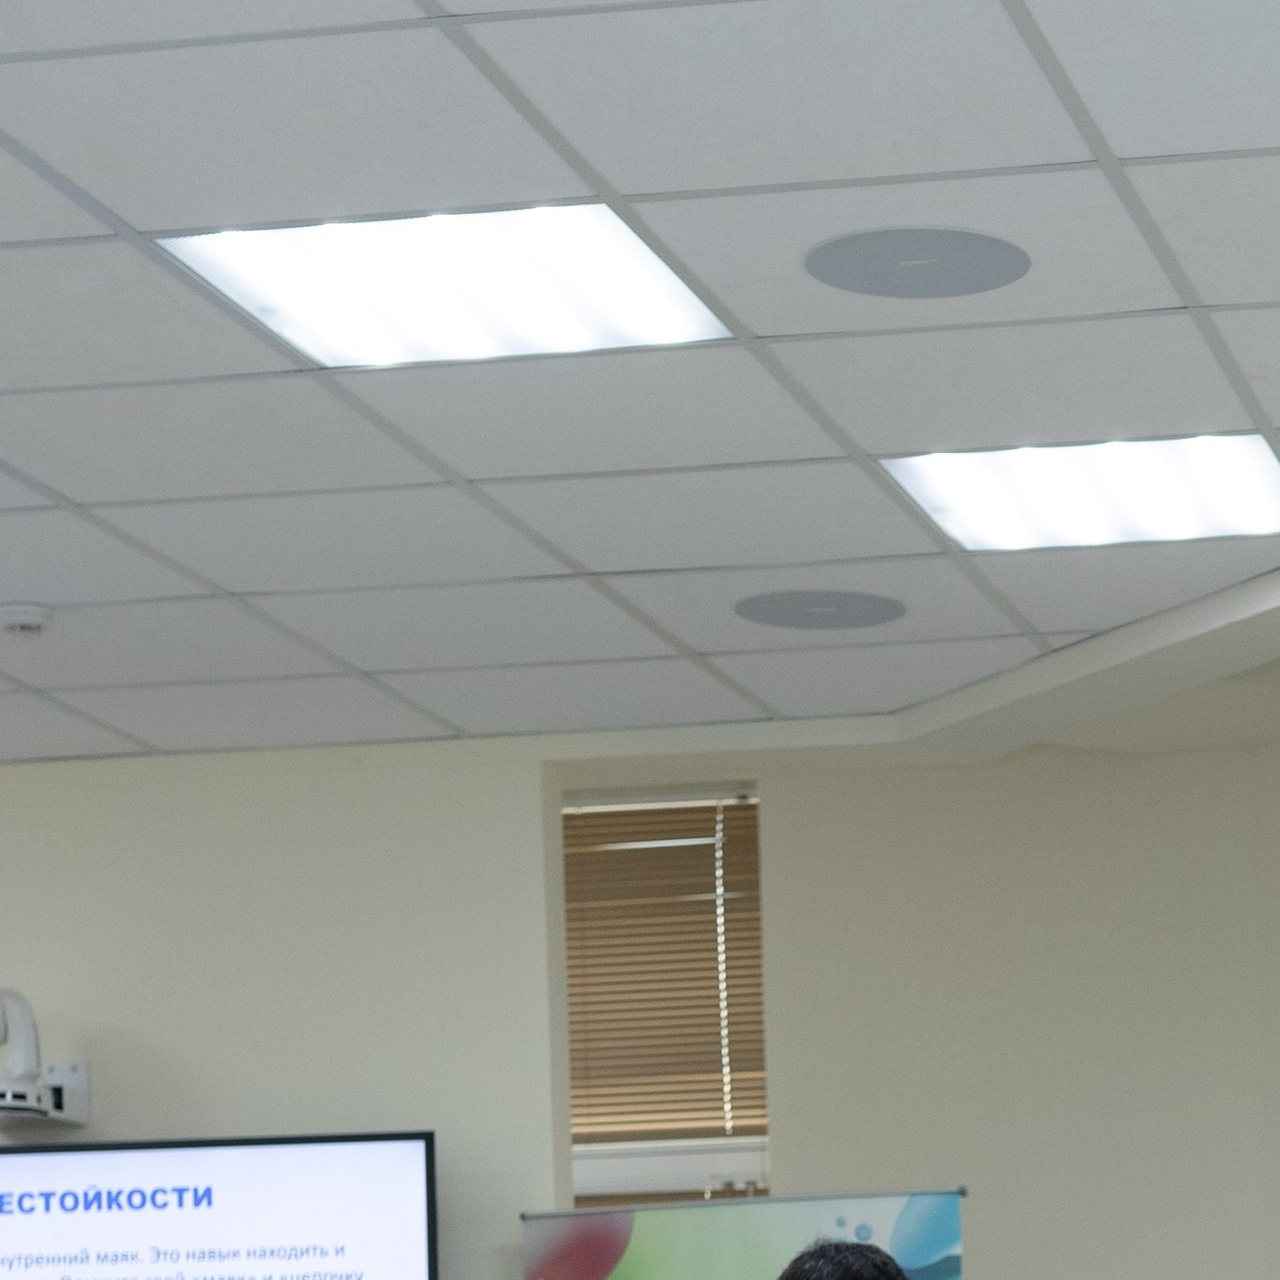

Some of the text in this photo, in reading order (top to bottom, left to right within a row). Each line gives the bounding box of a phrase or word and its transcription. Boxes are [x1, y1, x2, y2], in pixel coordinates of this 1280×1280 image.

[0, 1184, 214, 1215] ЕСТОЙКОСТИ
[95, 1251, 144, 1266] маяк.
[149, 1246, 181, 1265] Это
[185, 1248, 241, 1263] навык
[246, 1244, 329, 1261] находить
[334, 1244, 345, 1257] и
